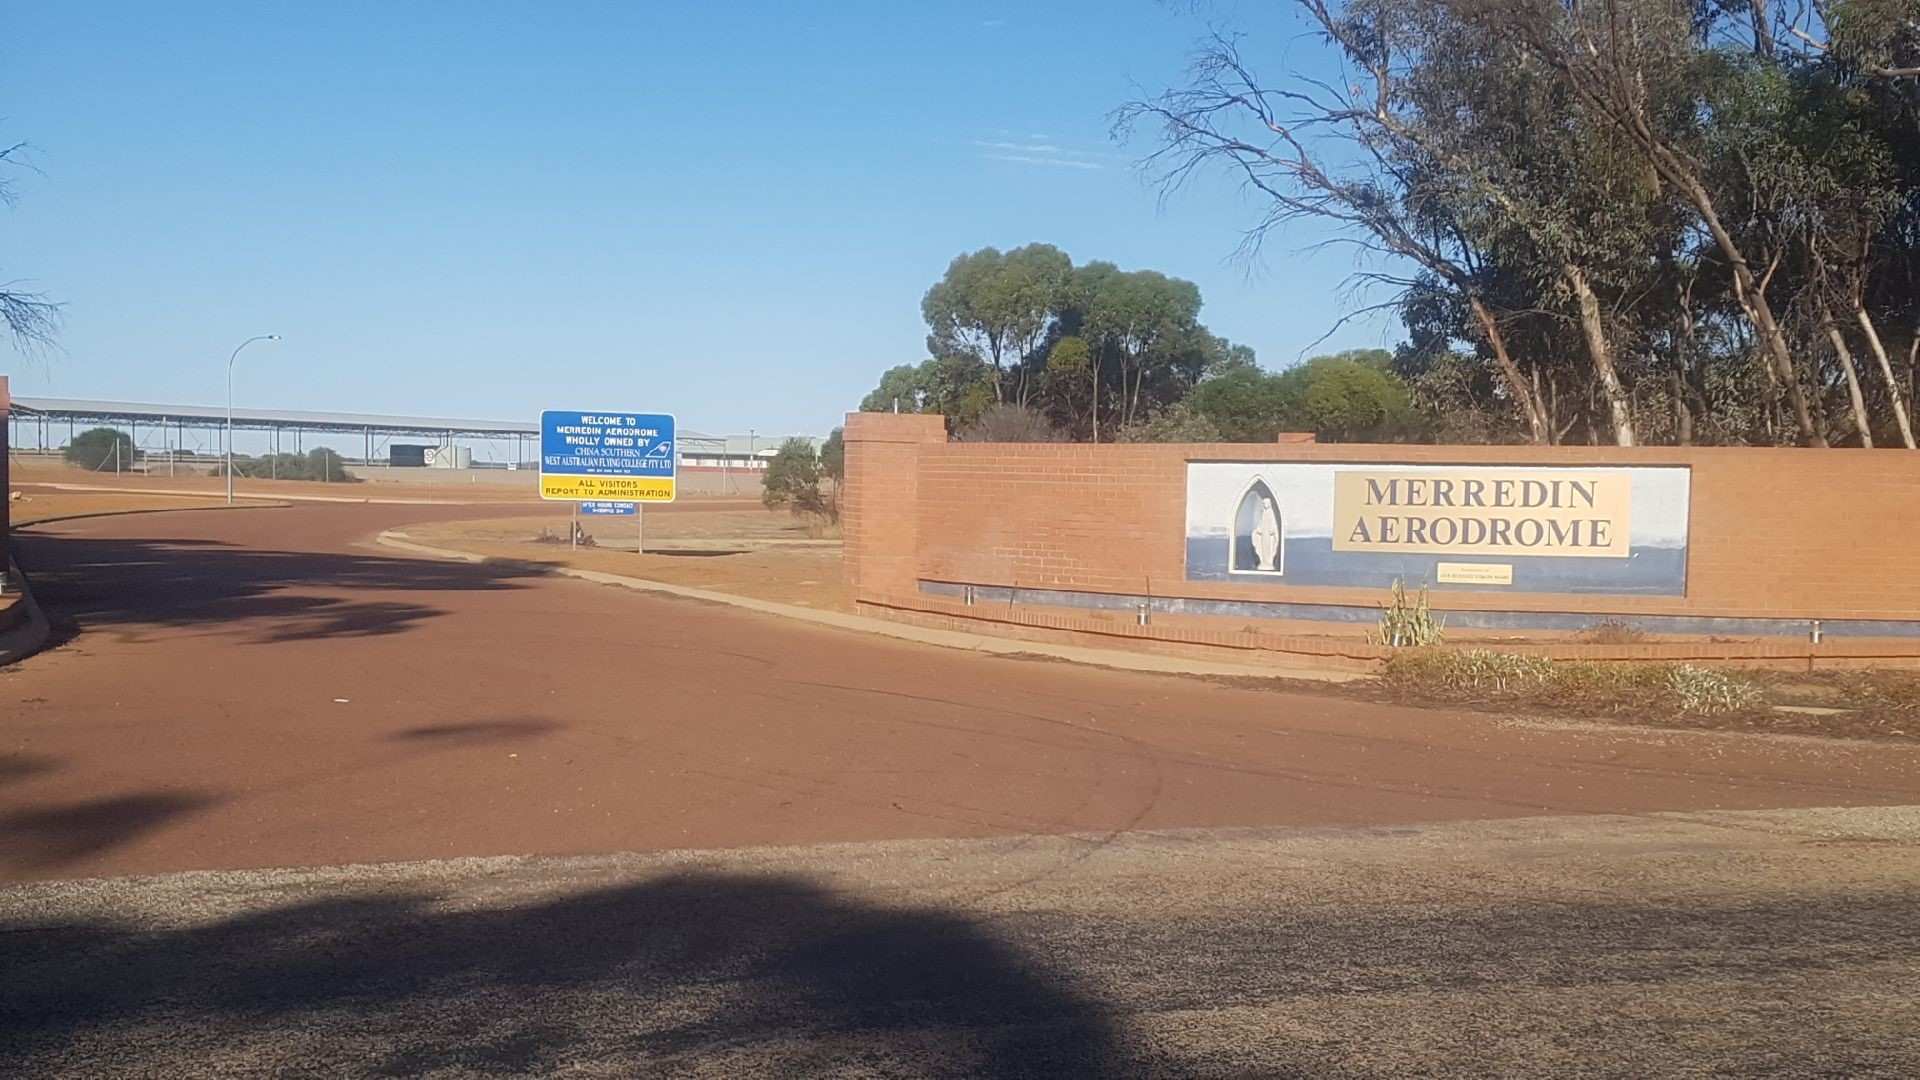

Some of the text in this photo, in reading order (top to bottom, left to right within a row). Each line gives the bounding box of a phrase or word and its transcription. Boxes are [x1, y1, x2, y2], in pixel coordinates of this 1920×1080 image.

[581, 416, 636, 426] WELCOME TO
[556, 426, 658, 436] MERREDIN AERODROME
[566, 436, 650, 446] WHOLLY OWNED BY
[575, 448, 640, 456] CHINA SOUTHERN
[544, 456, 560, 465] WEST
[562, 456, 598, 466] AUSTRALIAN
[599, 458, 620, 467] FLYING
[622, 459, 648, 468] COLLEGE
[660, 460, 671, 468] LTD
[598, 489, 670, 497] ADMINISTRATION
[1364, 478, 1598, 508] MERREDIN
[1347, 515, 1612, 548] AERODROME
